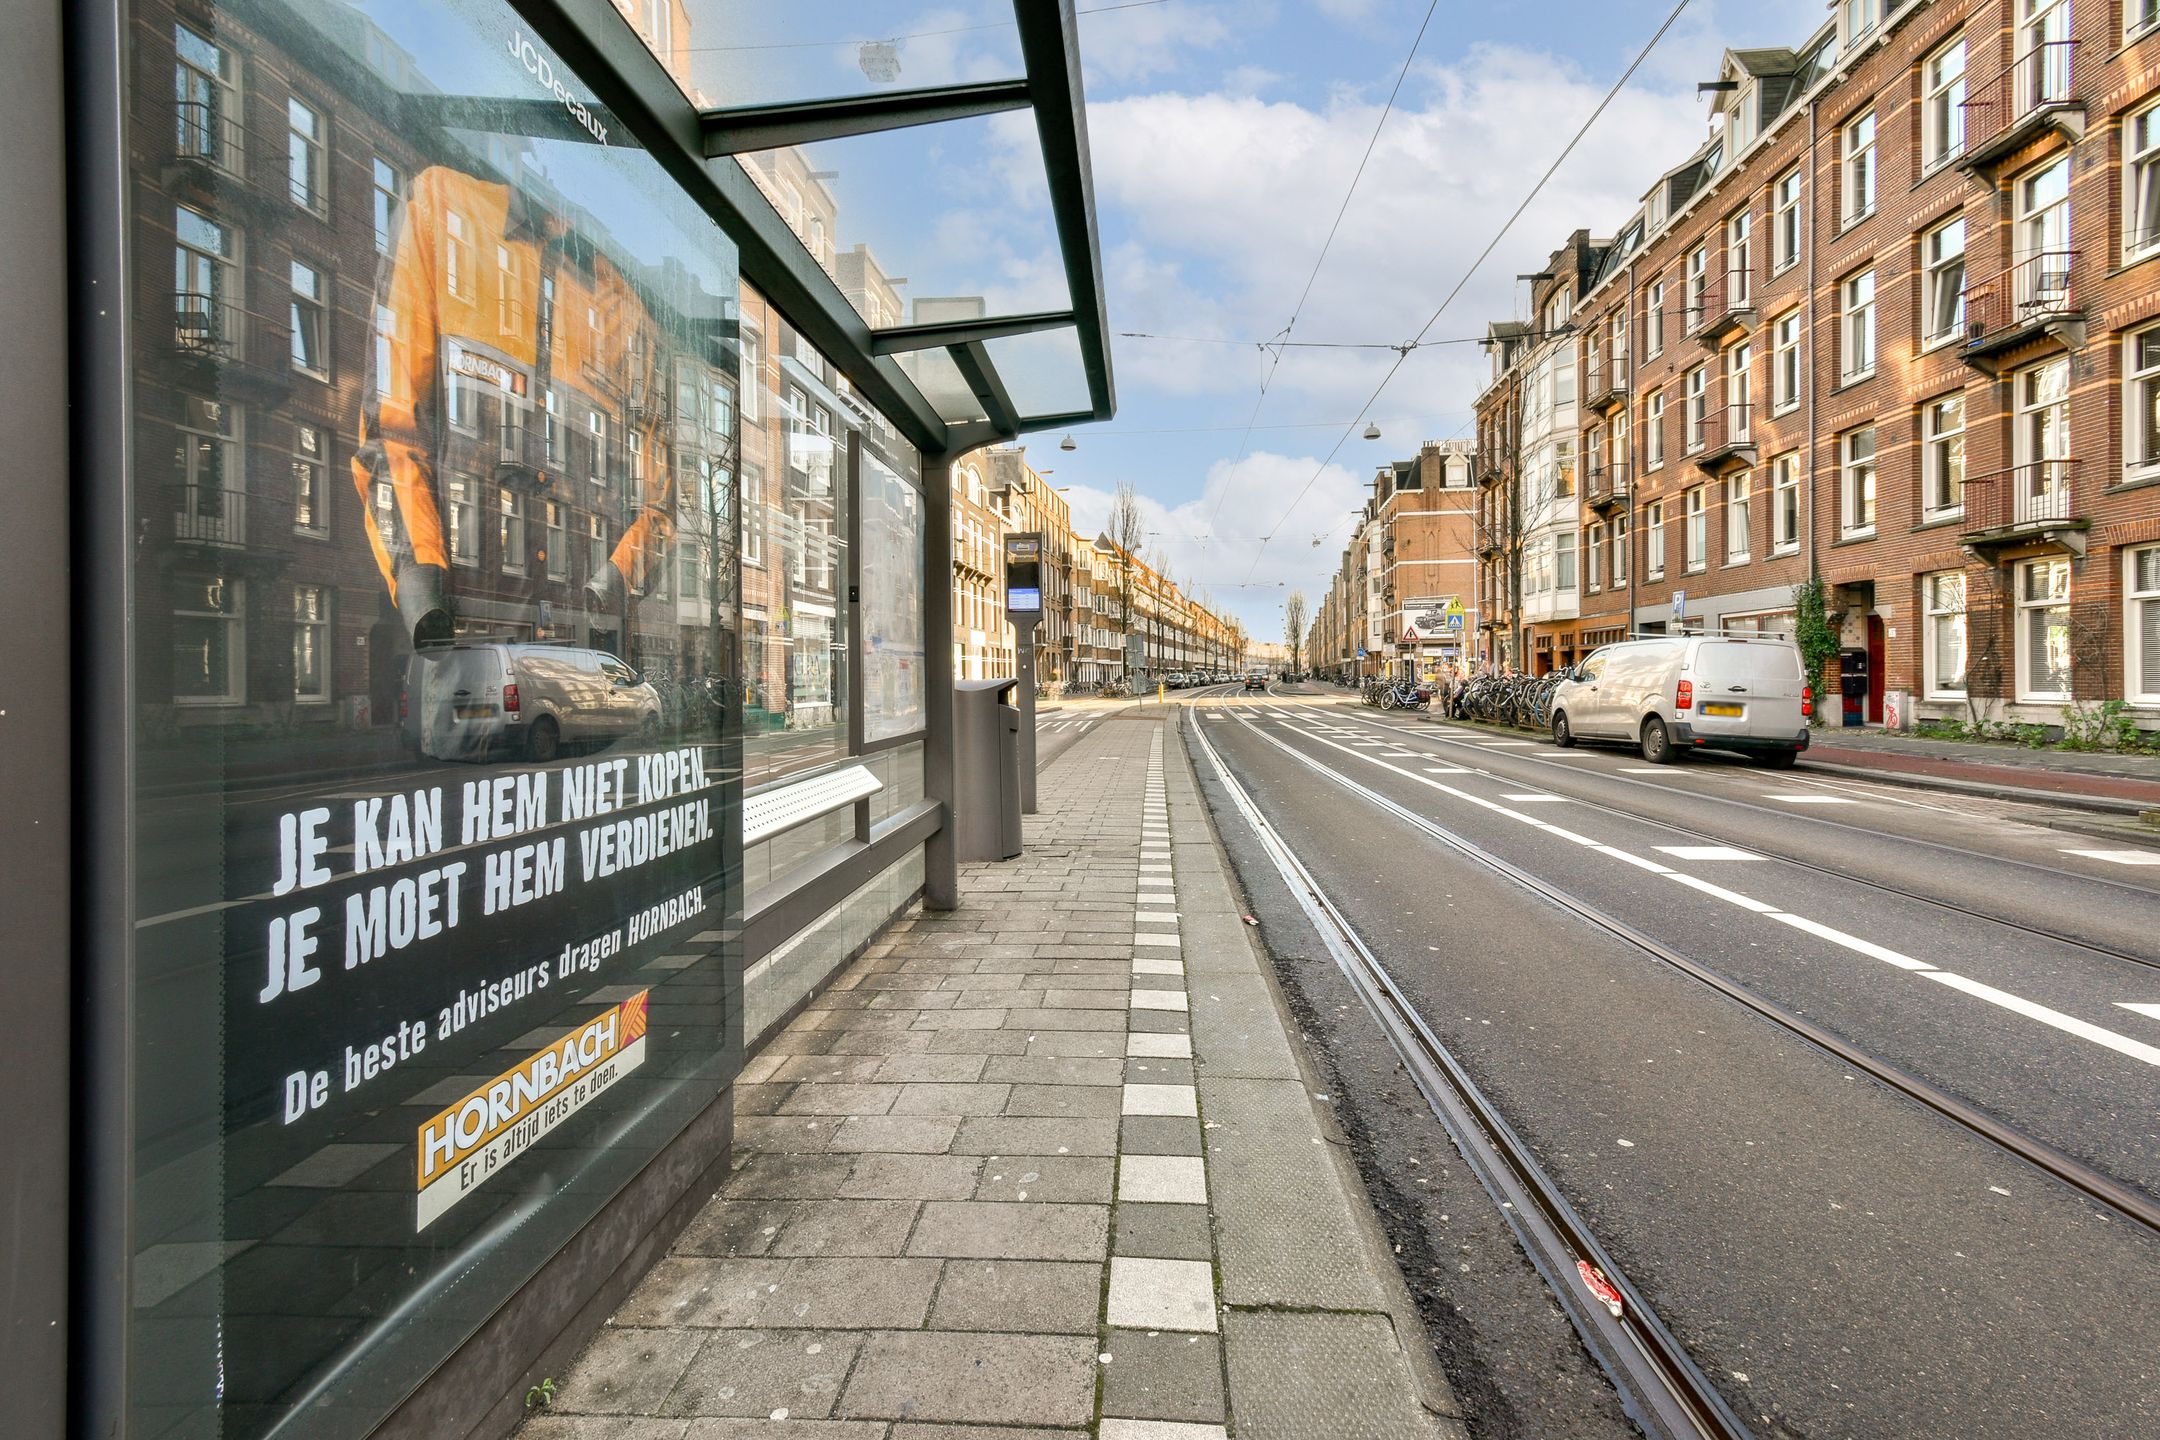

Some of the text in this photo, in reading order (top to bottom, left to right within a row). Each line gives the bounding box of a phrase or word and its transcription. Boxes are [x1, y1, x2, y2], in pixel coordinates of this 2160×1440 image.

[507, 30, 608, 146] JCDecaux
[273, 747, 711, 897] JE KAN HEM NIET KOPEN.
[259, 798, 713, 1004] JE MOET HEM VERDIENEN.
[284, 885, 707, 1125] De beste adviseurs dragen HORNBACH.
[423, 1014, 617, 1179] HORNBACH
[459, 1063, 619, 1192] Er is altijd iets te doen.
